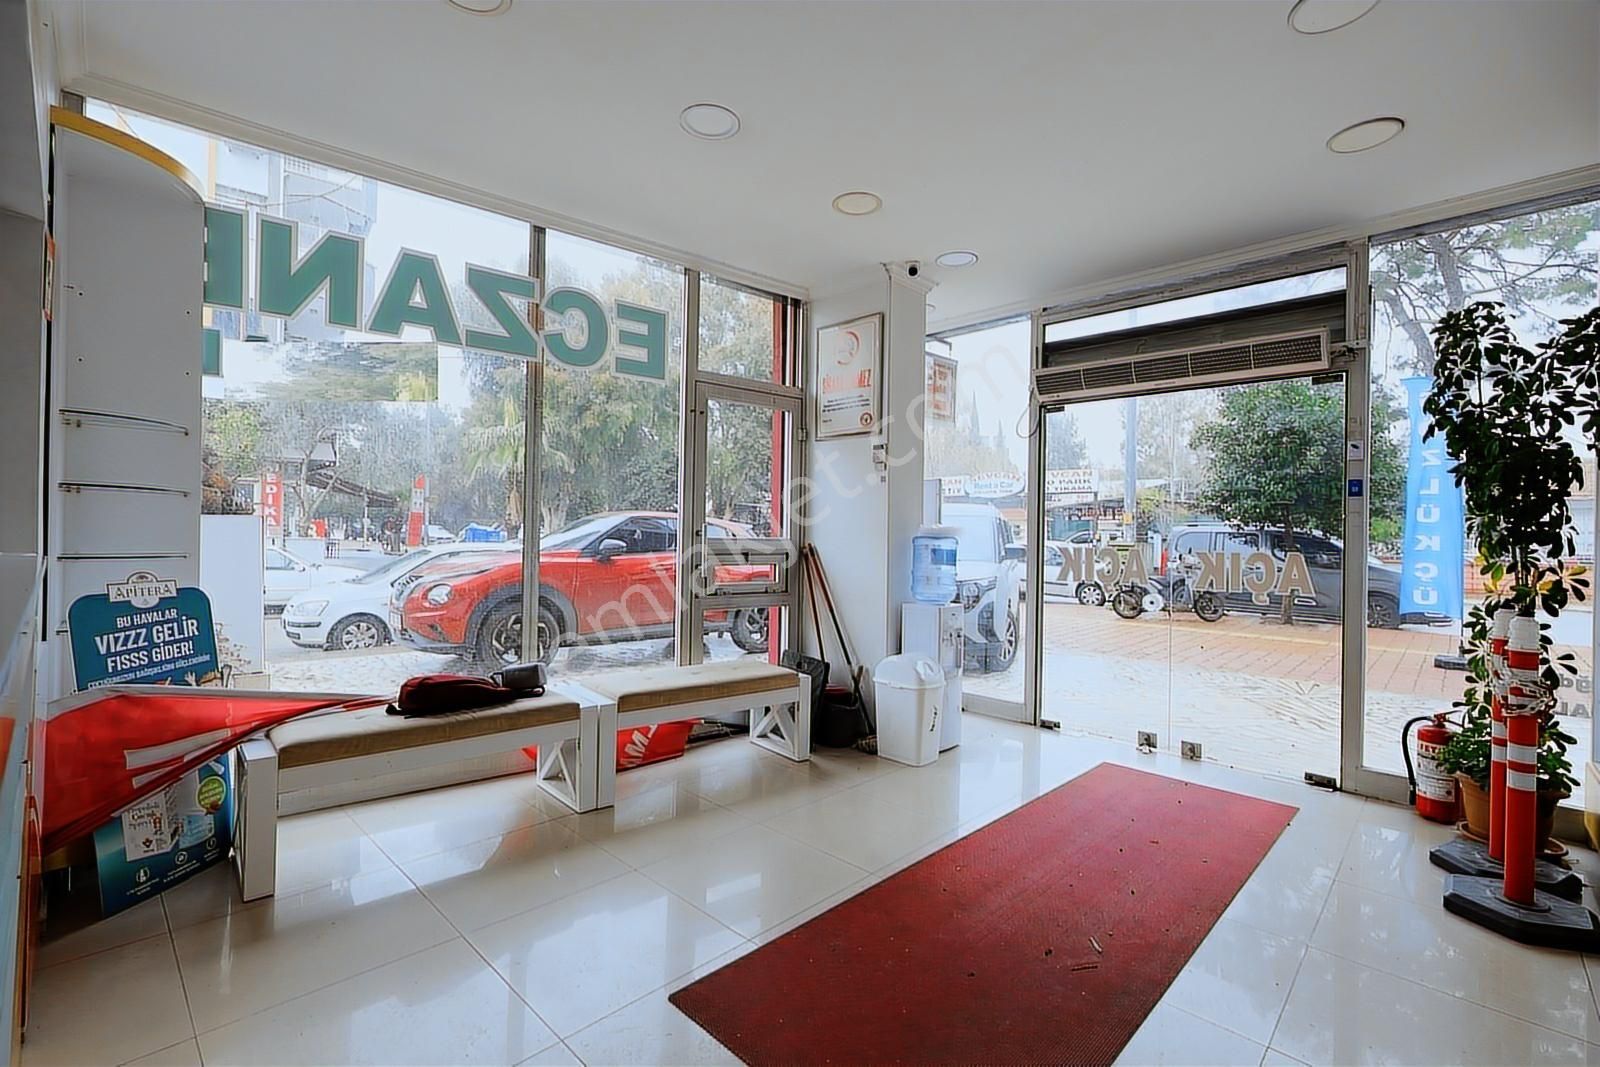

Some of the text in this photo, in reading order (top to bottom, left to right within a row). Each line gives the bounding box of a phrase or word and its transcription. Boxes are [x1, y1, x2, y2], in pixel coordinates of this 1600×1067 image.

[116, 608, 178, 628] BU HAVALAR
[94, 615, 199, 655] VIZZZ GELİR
[107, 640, 194, 673] FISSS GİDER!
